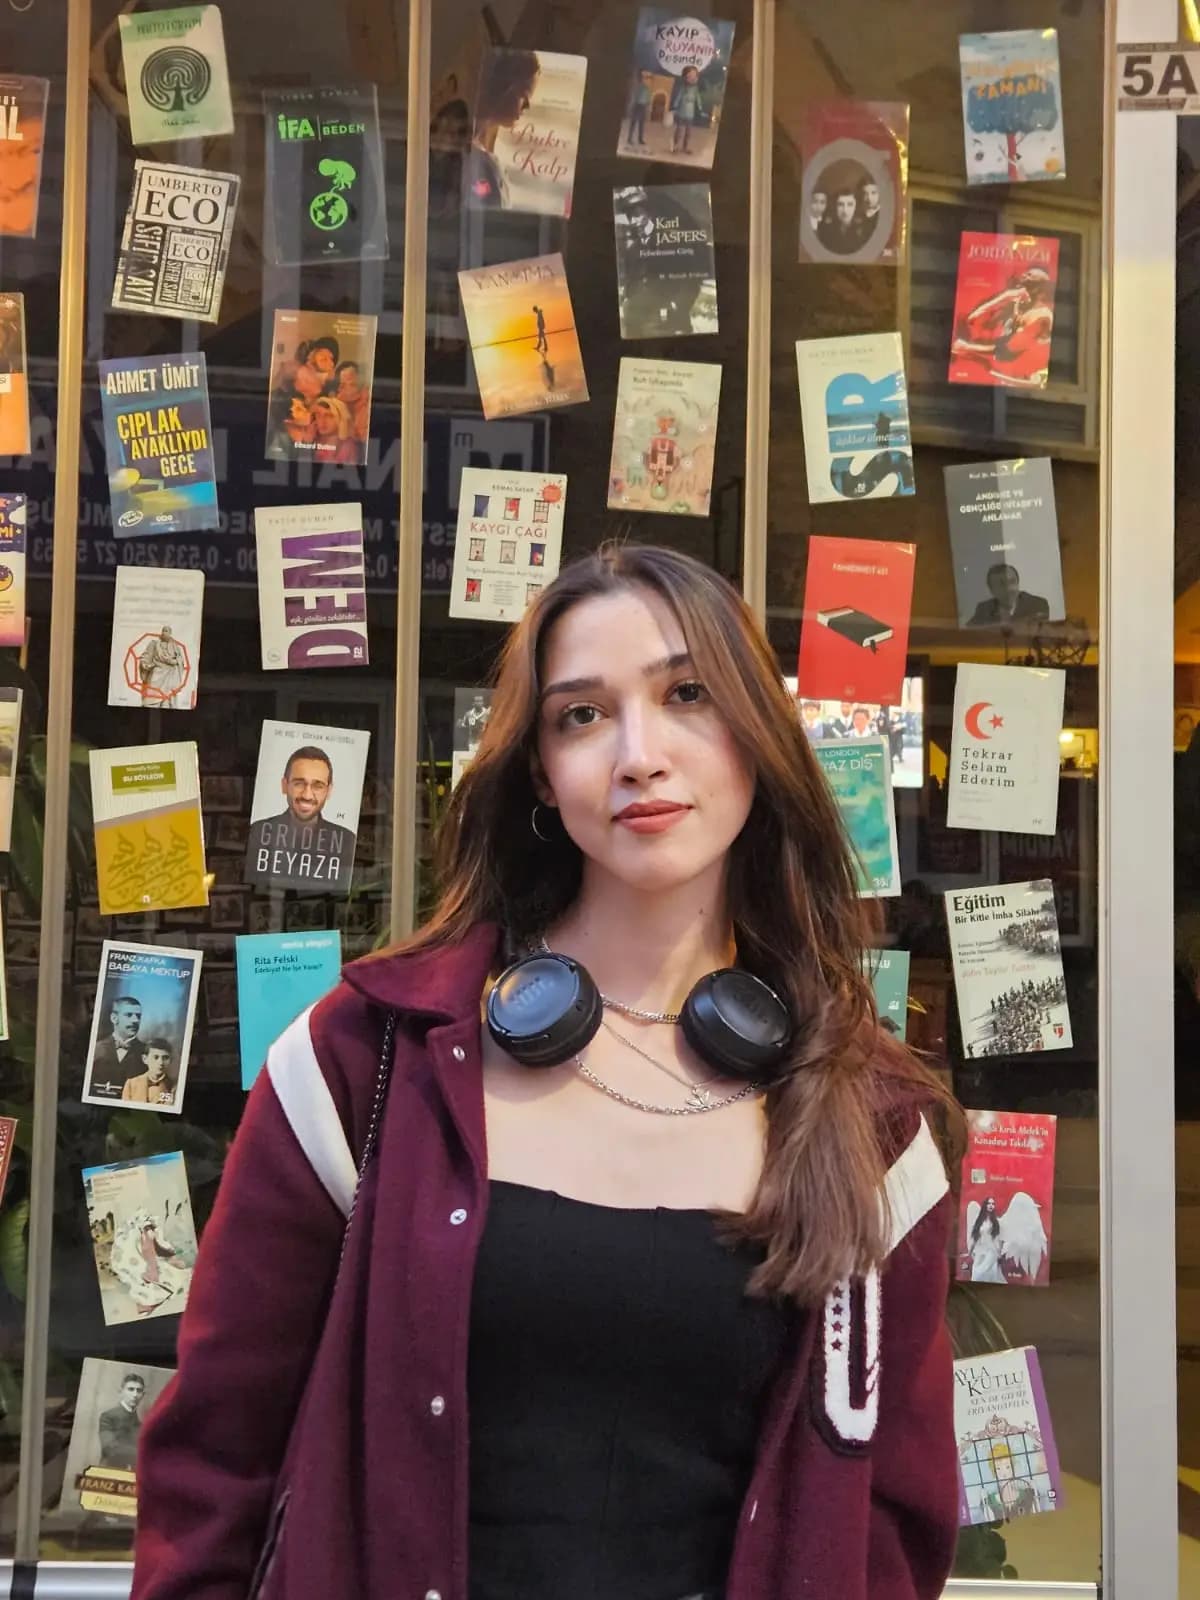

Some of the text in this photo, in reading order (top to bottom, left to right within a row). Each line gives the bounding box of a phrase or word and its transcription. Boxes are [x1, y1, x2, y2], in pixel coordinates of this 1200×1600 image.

[655, 25, 699, 41] KAYIP
[1122, 54, 1198, 97] 5A
[278, 113, 315, 140] İFA
[323, 123, 366, 136] BEDEN
[148, 175, 222, 197] UMBERTO
[143, 190, 220, 225] ECO
[656, 217, 680, 229] Karl
[656, 230, 708, 246] JASPERS
[172, 243, 210, 262] ECO
[106, 361, 201, 396] AHMET ÜMİT
[118, 406, 184, 445] ÇIPLAK
[133, 429, 208, 460] AYAKLIYDI
[160, 454, 198, 478] GECE
[470, 522, 511, 536] KAYGI
[962, 747, 1013, 761] Tekrar
[961, 760, 1008, 774] Selam
[960, 774, 1016, 788] Ederim
[256, 848, 341, 880] BEYAZA
[952, 893, 1006, 914] Eğitim
[955, 915, 967, 924] Bir
[970, 911, 990, 922] Kitle
[109, 952, 137, 963] FRANZ
[254, 954, 299, 966] Rita Felski
[108, 962, 191, 979] BABAYA MEKTUP
[967, 1370, 1024, 1397] KUTLU
